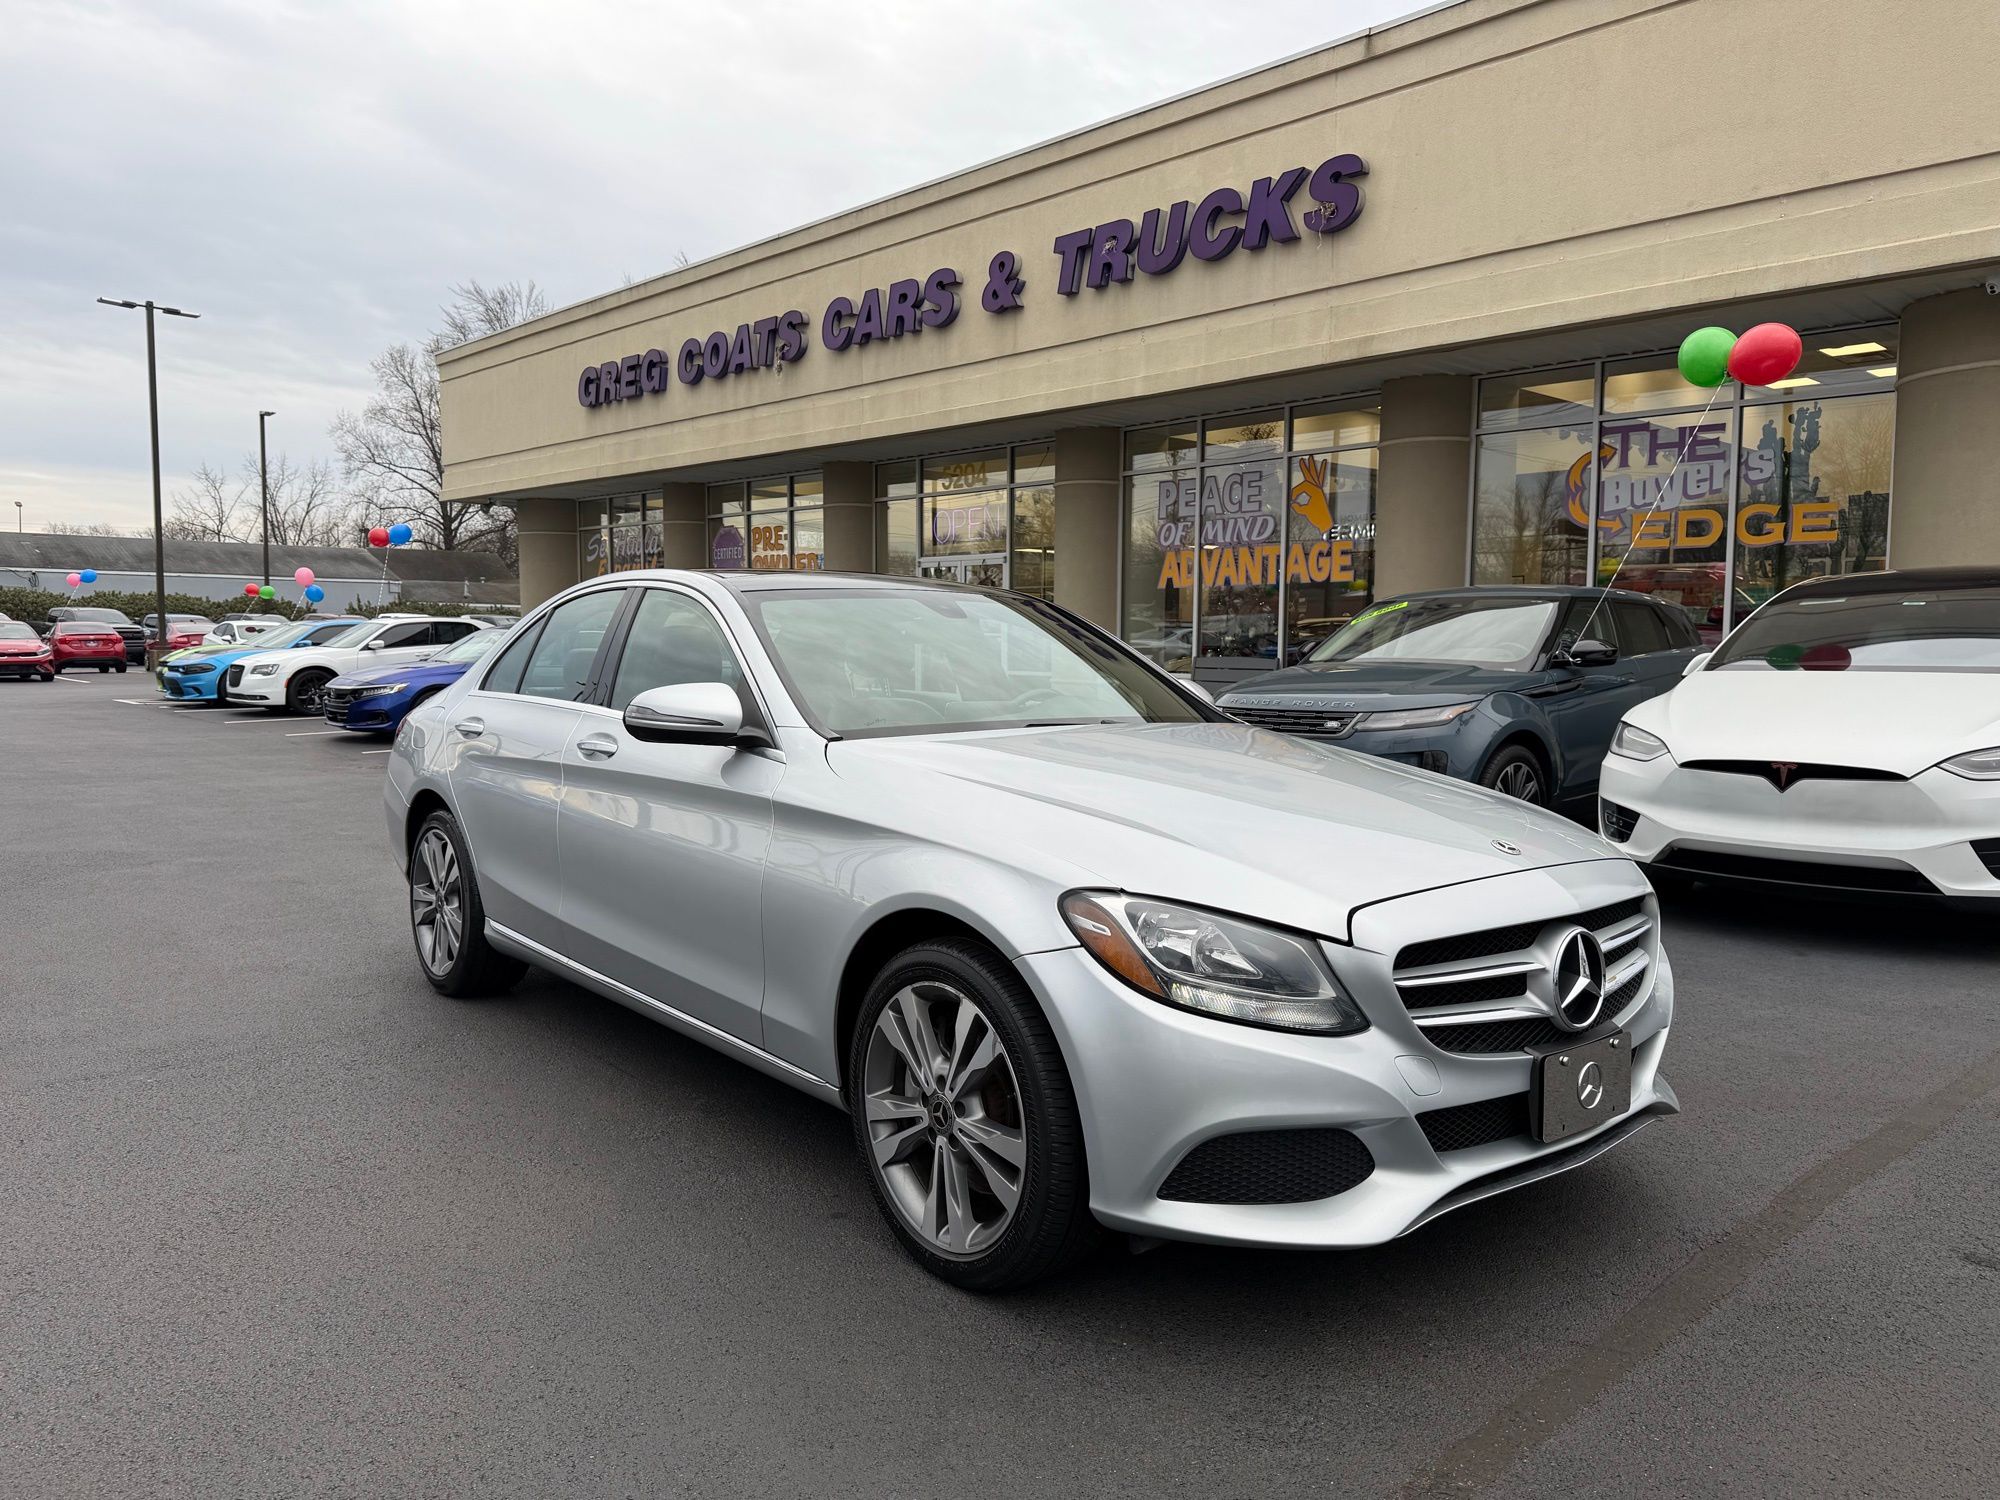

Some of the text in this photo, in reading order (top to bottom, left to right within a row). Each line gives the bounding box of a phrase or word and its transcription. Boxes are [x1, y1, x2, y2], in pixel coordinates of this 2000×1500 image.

[578, 153, 1370, 408] GREG COATS CARS & TRUCKS
[1600, 421, 1727, 469] THE
[941, 462, 988, 490] 5204
[1158, 470, 1263, 520] PEACE
[751, 525, 788, 553] PRE-
[932, 506, 1001, 545] OPEN
[1158, 515, 1276, 547] OF MIND
[1631, 501, 1839, 550] EDGE
[713, 546, 742, 560] CERTIFIED
[1158, 541, 1355, 590] ADVANTAGE
[1230, 697, 1357, 708] RANGE ROVER
